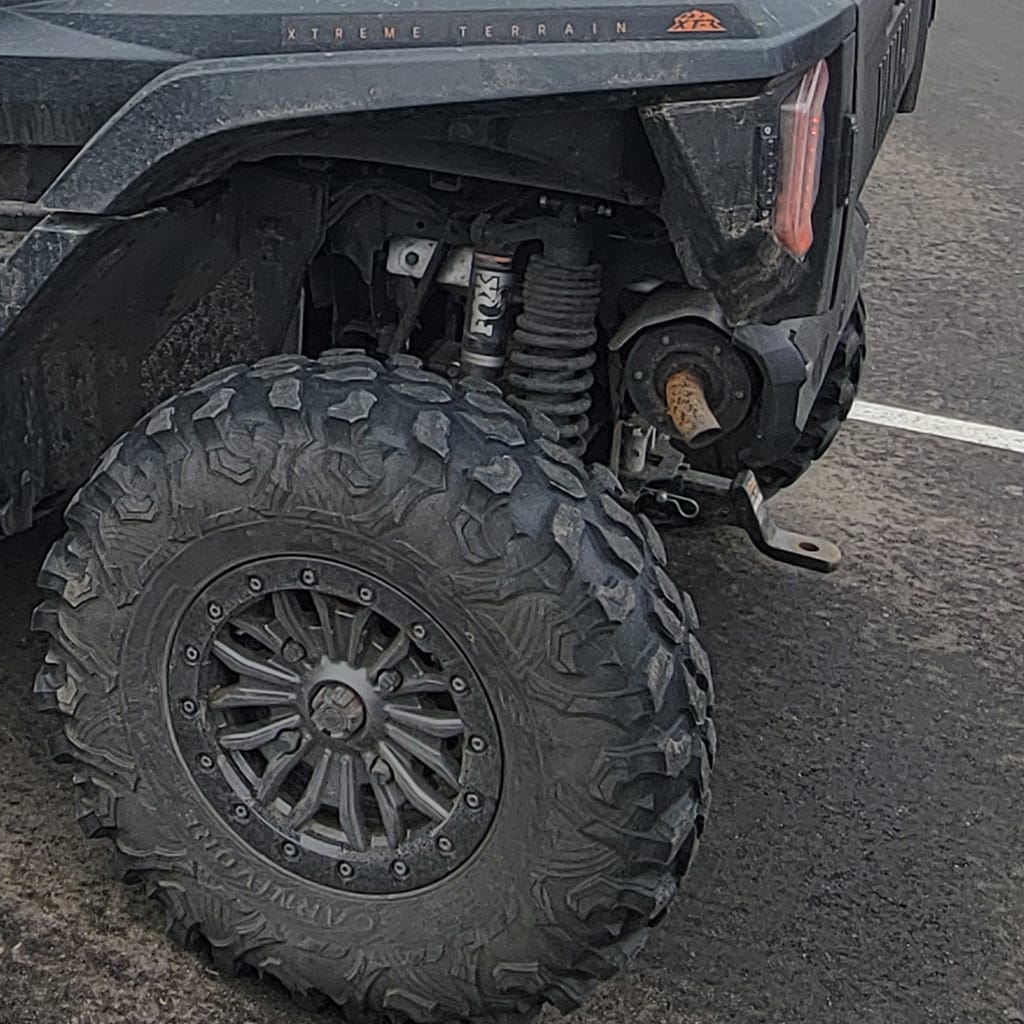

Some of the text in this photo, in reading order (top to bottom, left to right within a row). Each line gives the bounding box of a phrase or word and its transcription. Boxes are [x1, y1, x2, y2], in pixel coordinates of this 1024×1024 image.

[287, 22, 626, 40] XTREME TERRAIN
[470, 273, 505, 337] FOX
